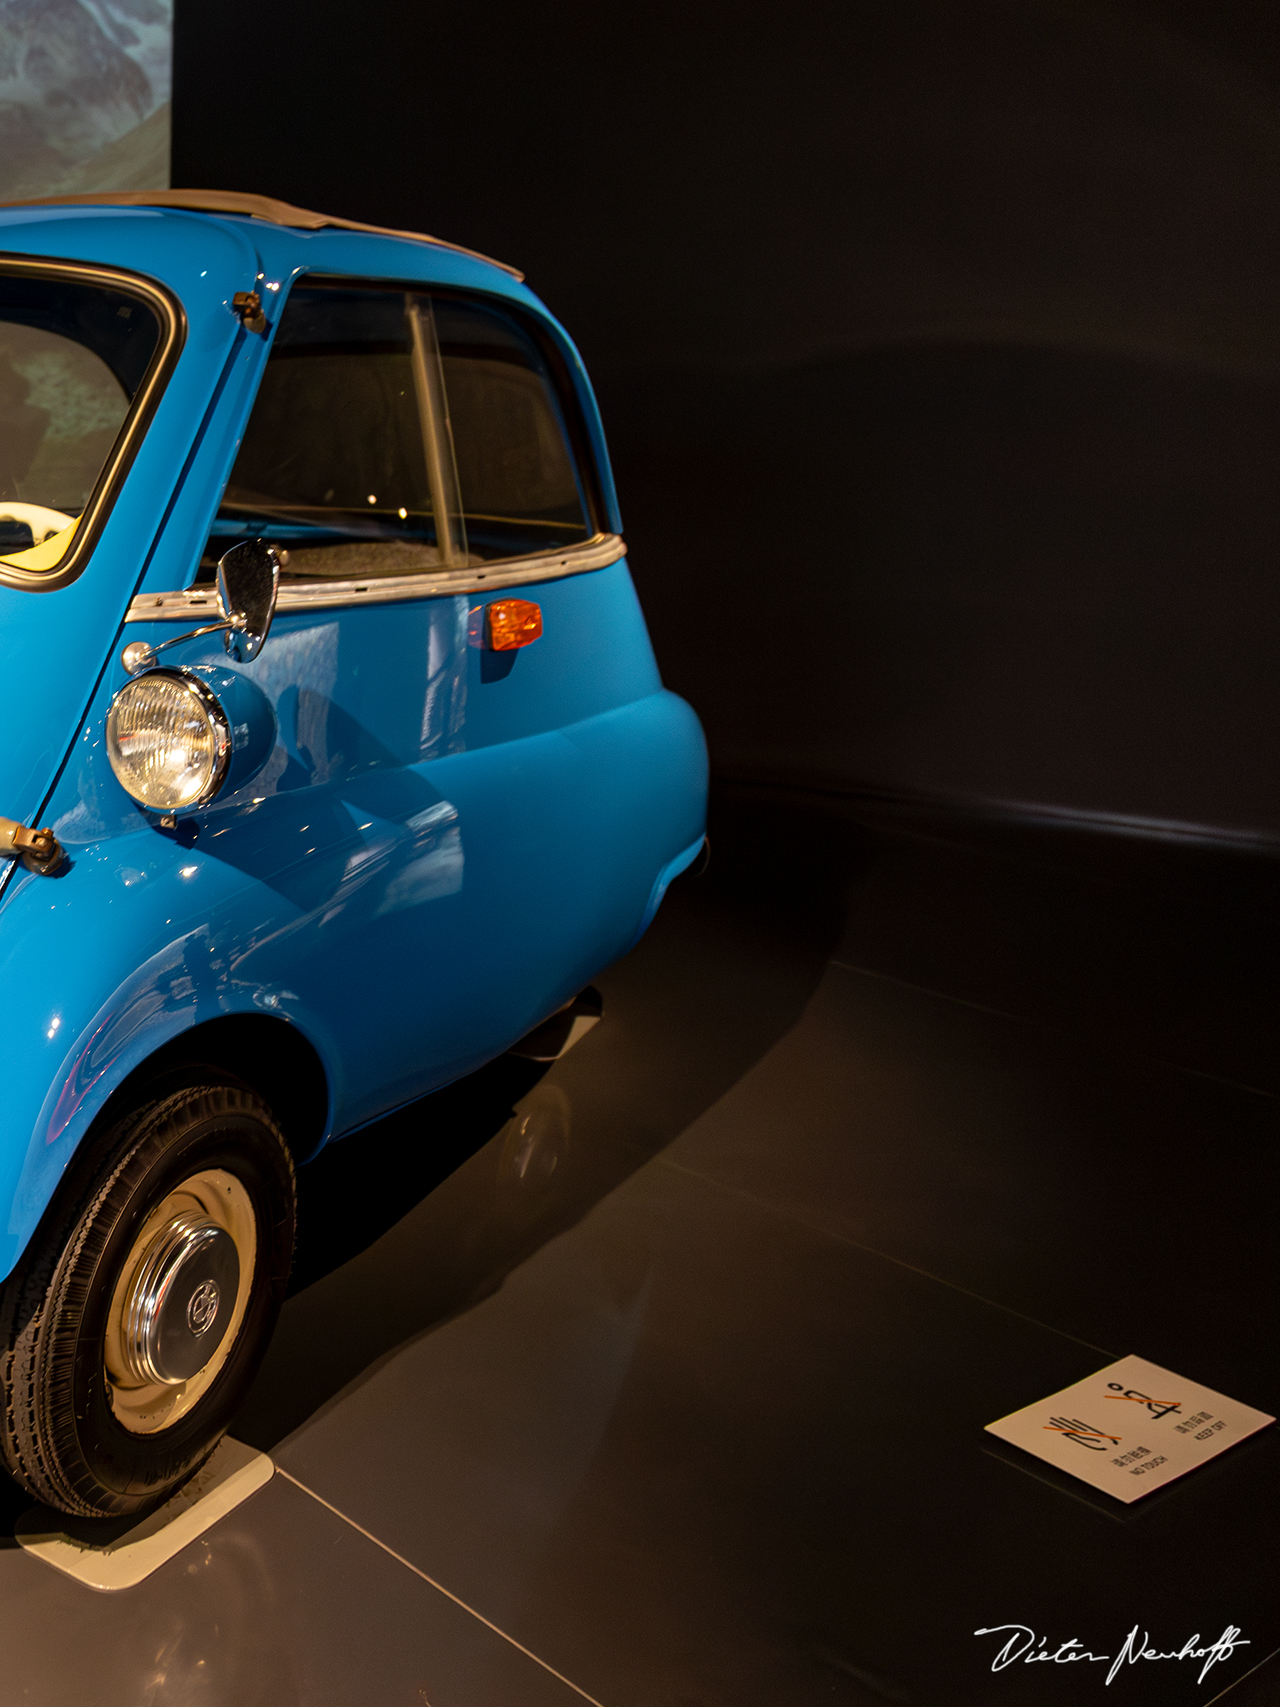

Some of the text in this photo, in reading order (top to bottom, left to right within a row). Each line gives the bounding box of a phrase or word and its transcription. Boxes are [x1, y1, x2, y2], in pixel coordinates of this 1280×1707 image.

[1194, 1420, 1227, 1440] KEEP OFF
[1128, 1455, 1168, 1476] NO TOUCH
